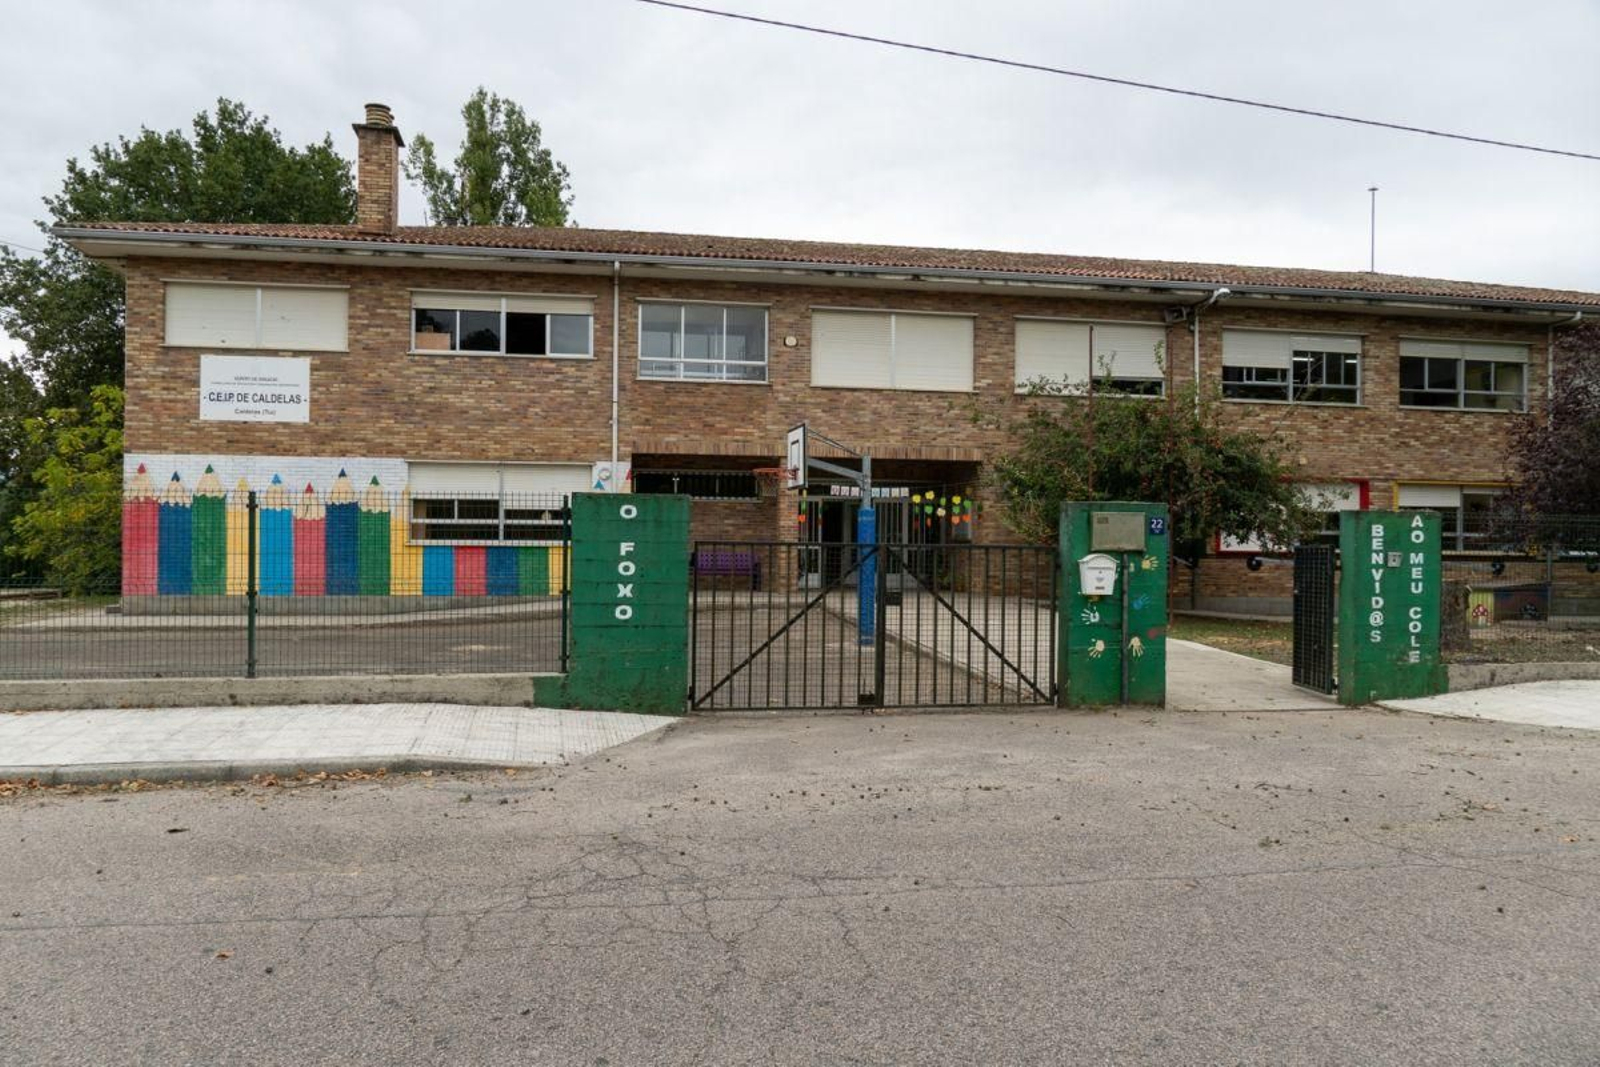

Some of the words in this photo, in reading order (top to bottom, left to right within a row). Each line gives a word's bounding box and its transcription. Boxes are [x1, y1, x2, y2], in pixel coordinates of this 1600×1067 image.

[236, 392, 249, 403] DE
[252, 393, 302, 404] CALDELAS
[619, 504, 638, 519] O
[1151, 519, 1163, 529] 22
[1410, 515, 1425, 543] AO
[615, 542, 636, 620] FOXO
[1369, 524, 1385, 643] BENVID@S
[1409, 552, 1424, 594] MEU
[1408, 606, 1422, 663] COLE
